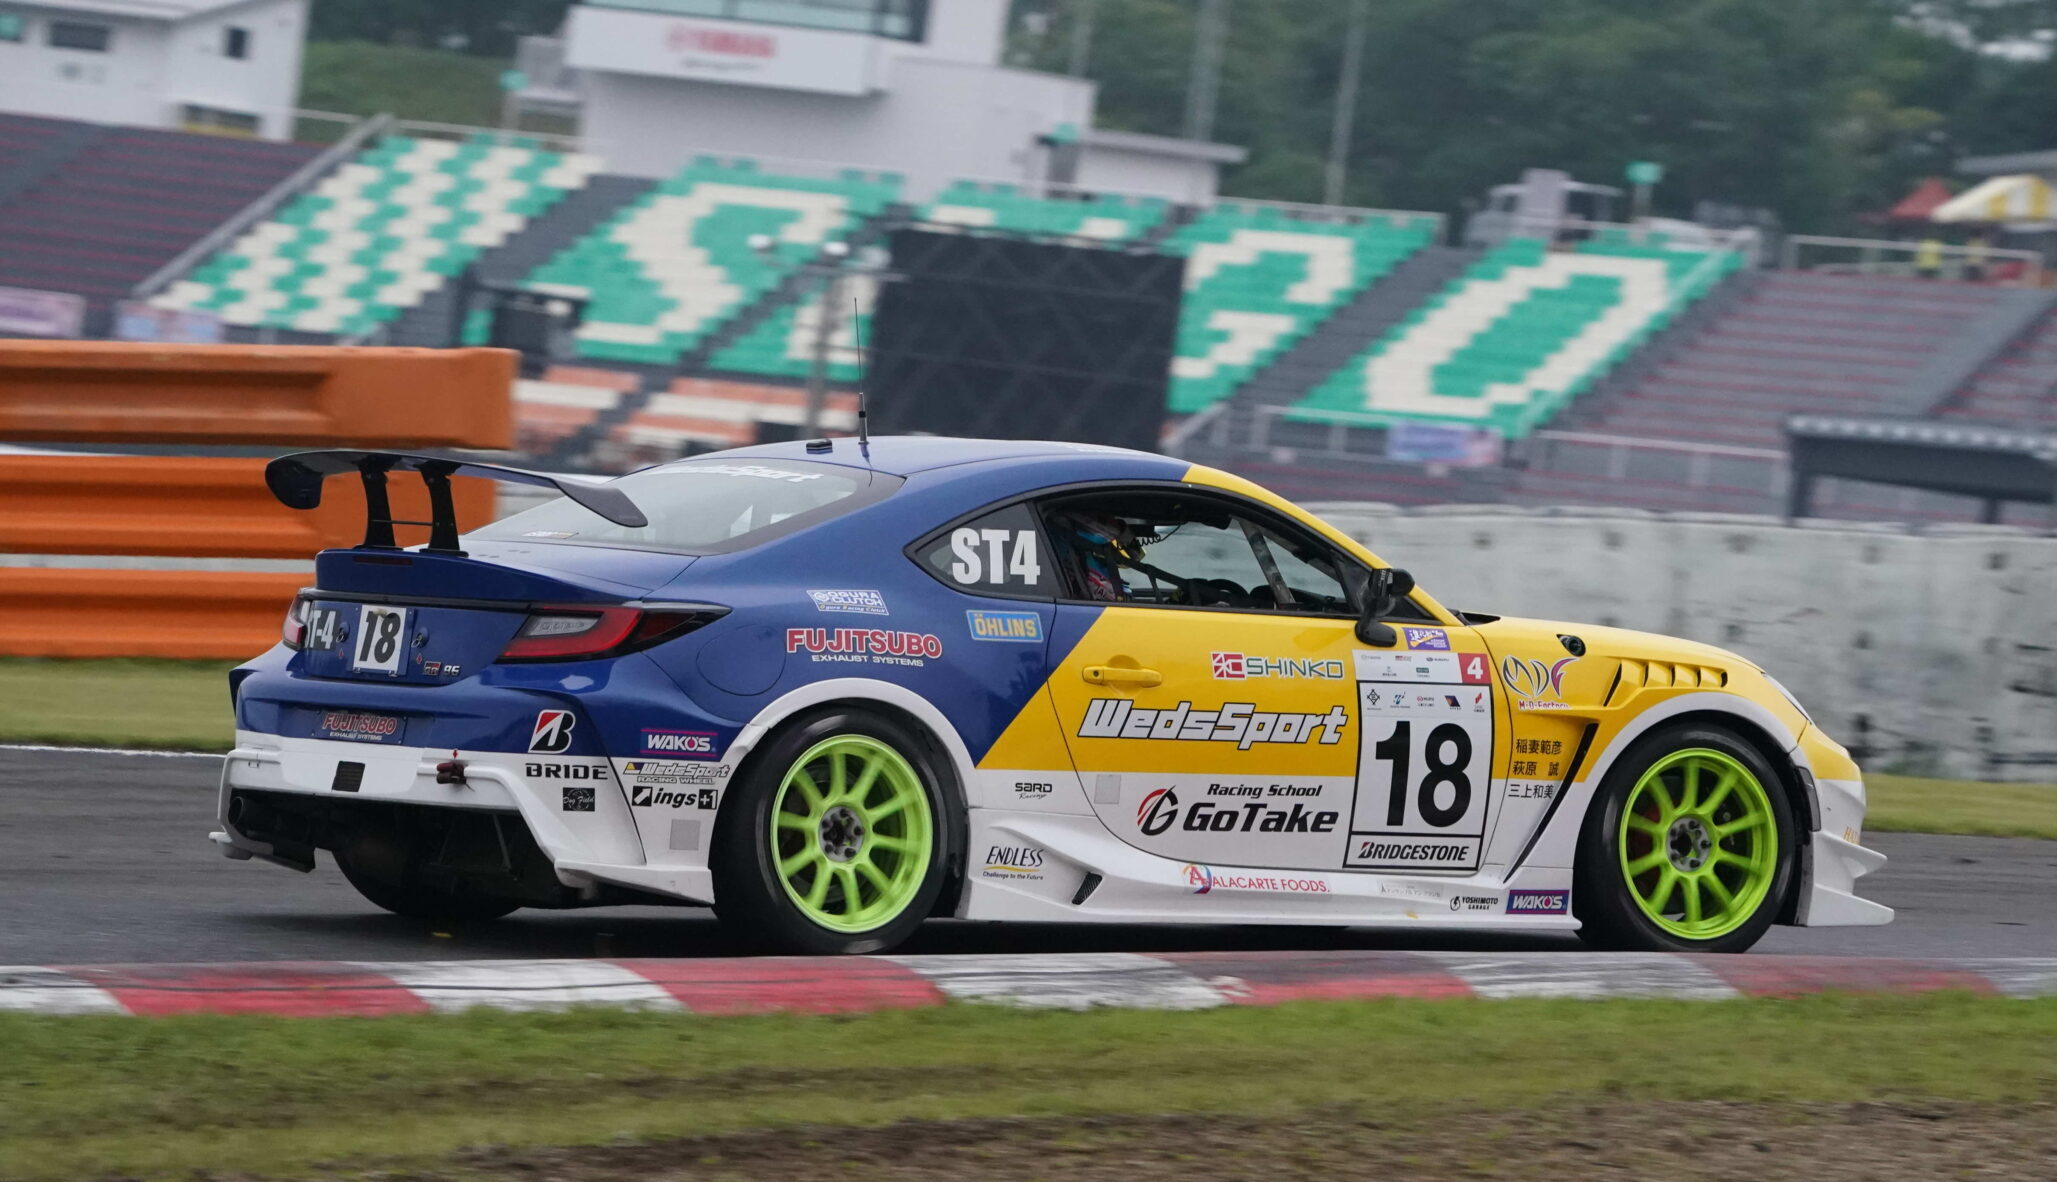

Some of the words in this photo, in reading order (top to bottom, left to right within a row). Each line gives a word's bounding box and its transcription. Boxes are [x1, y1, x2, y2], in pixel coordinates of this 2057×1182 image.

[951, 528, 1041, 585] ST4
[827, 591, 880, 599] OGURA
[832, 597, 883, 607] CLUTCH
[974, 613, 1037, 638] ÖHLINS
[358, 610, 402, 664] 18
[786, 628, 943, 659] FUJITSUBO
[811, 654, 869, 664] EXHAUST
[872, 656, 924, 668] SYSTEMS
[1246, 657, 1344, 679] SHINKO
[1467, 657, 1484, 680] 4
[322, 712, 398, 735] FUJITSUBO
[1077, 698, 1348, 750] WedsSport
[330, 731, 358, 739] EXHAUST
[525, 762, 608, 780] BRIDE
[637, 776, 677, 784] RACING
[679, 777, 714, 785] WHEEL
[640, 762, 730, 779] WedsSport
[1375, 720, 1472, 828] 18
[653, 787, 697, 808] ings
[1207, 784, 1263, 798] Racing
[1267, 784, 1323, 797] School
[1508, 784, 1554, 799] 三上和美
[1182, 803, 1339, 833] GoTake
[985, 845, 1045, 868] ENDLESS
[1358, 841, 1469, 862] BRIDGESTONE
[983, 871, 1009, 880] Challenge
[1212, 876, 1278, 891] ALACARTE
[1462, 896, 1499, 905] YOSHIMOTO
